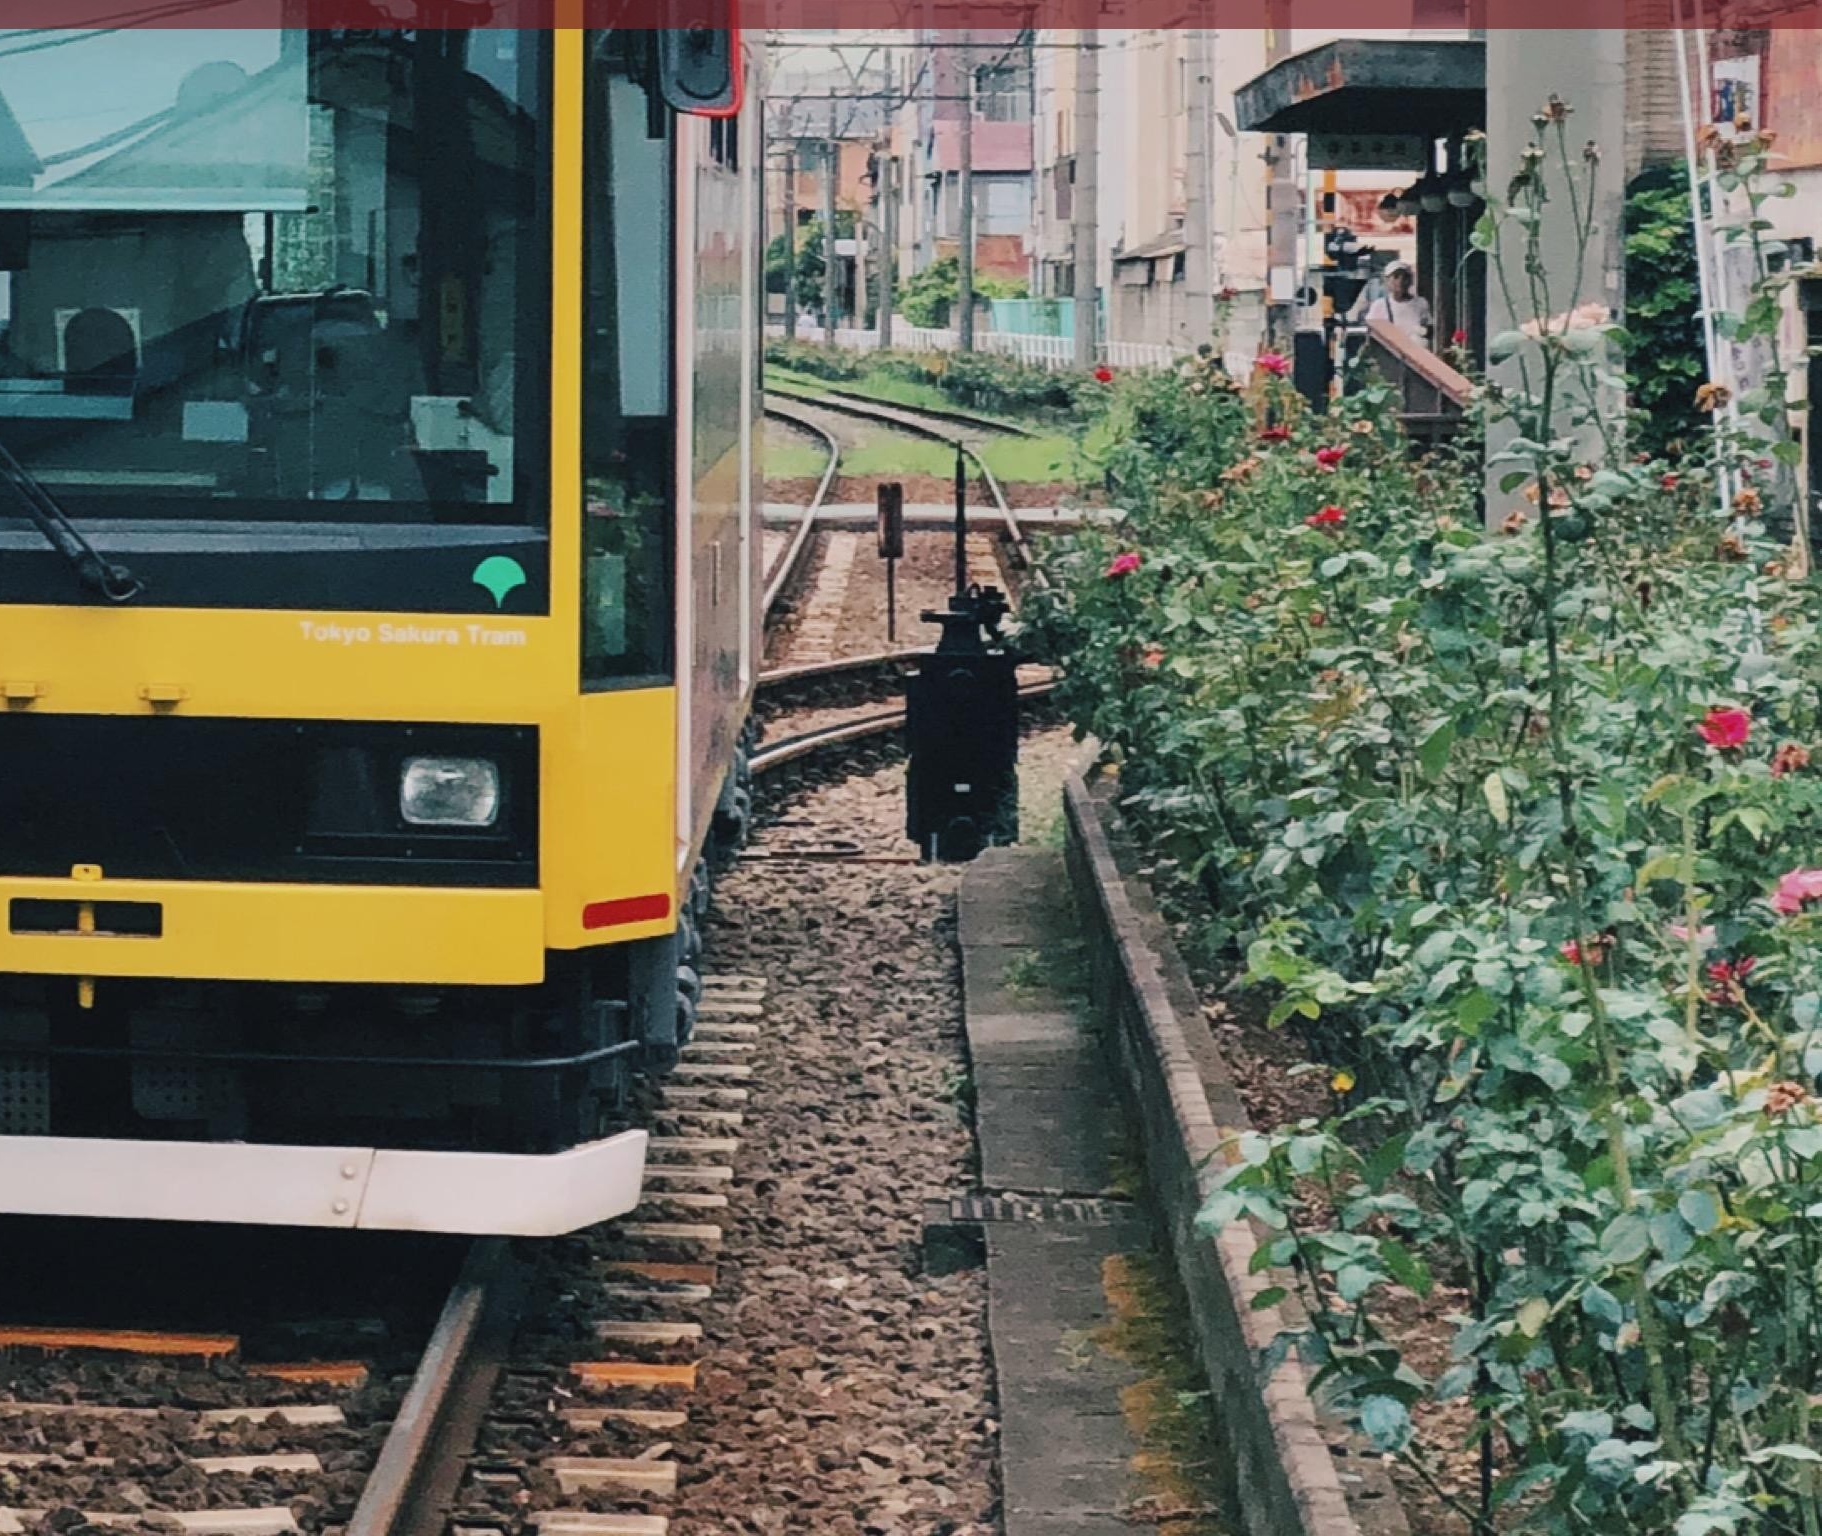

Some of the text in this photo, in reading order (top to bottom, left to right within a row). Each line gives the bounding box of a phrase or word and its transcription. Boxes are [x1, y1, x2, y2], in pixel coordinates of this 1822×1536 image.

[299, 621, 527, 646] Tokyo Sakura Tram
